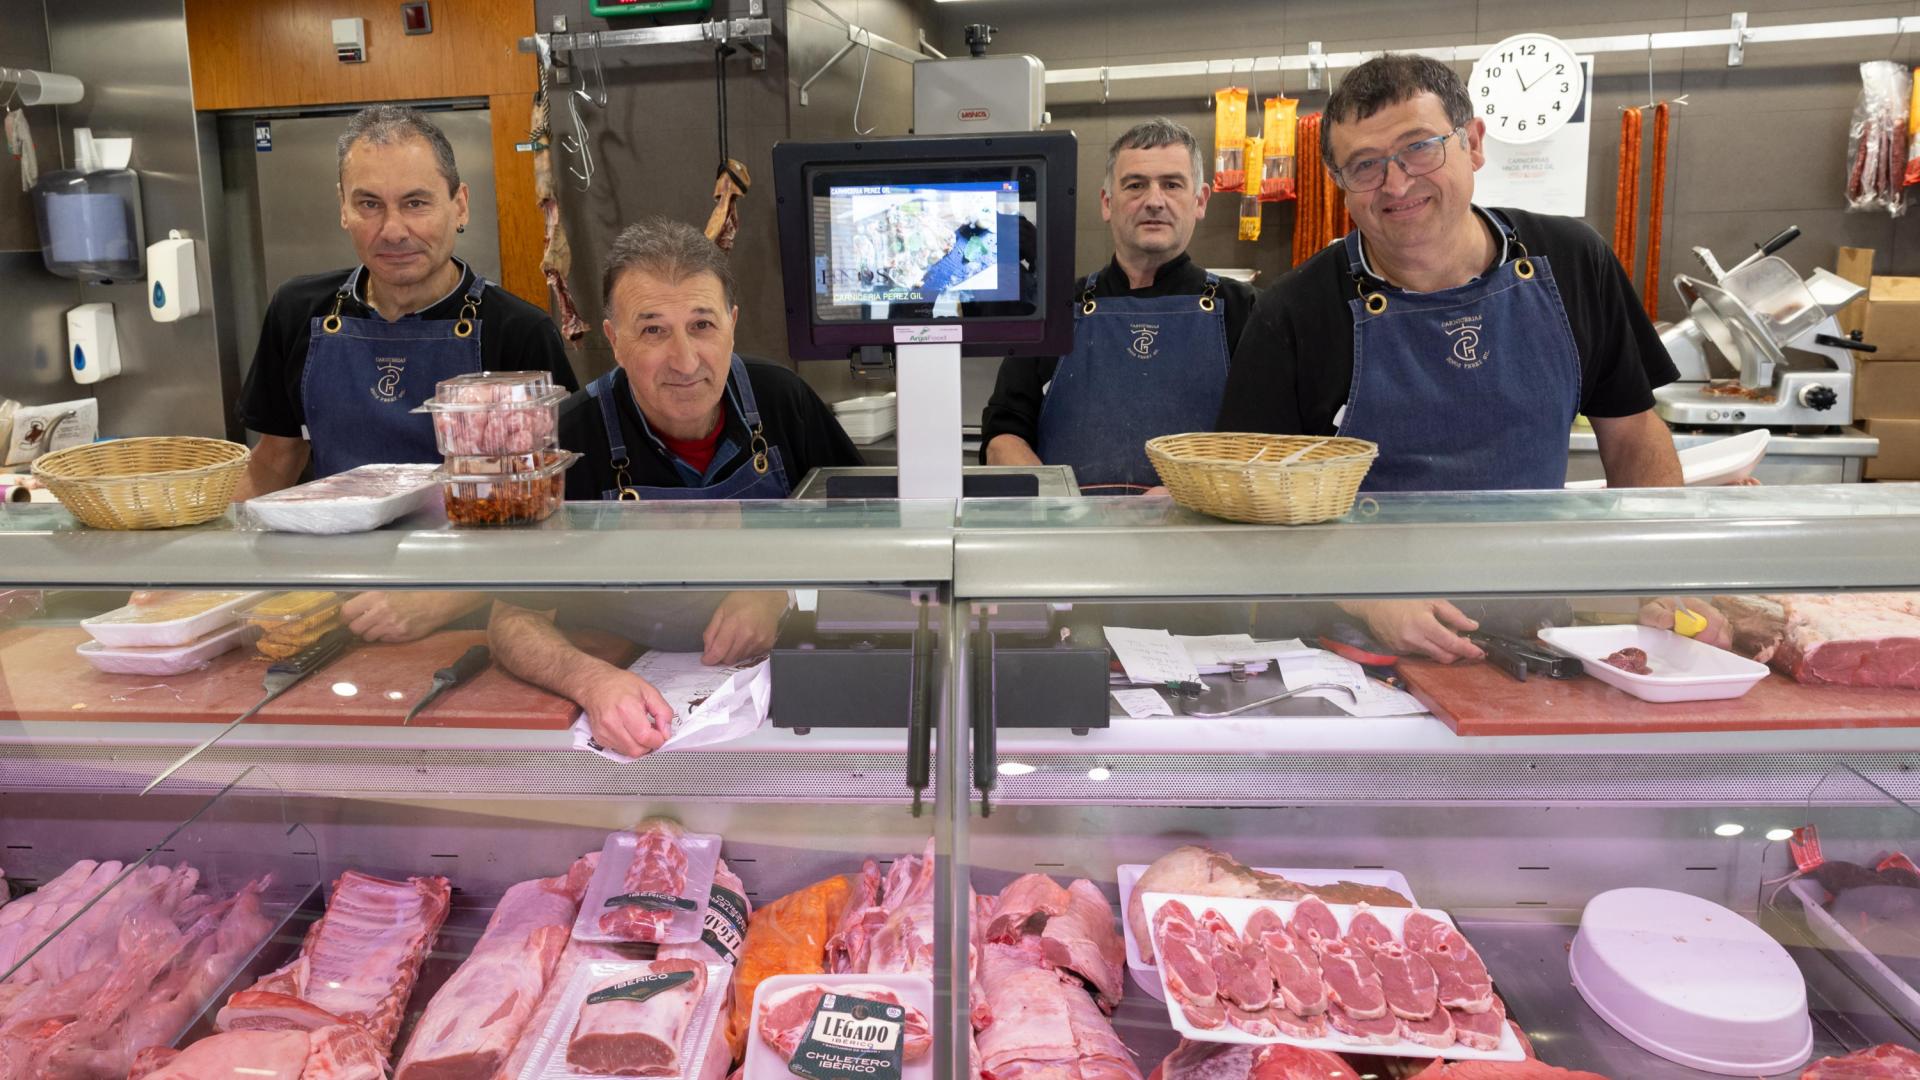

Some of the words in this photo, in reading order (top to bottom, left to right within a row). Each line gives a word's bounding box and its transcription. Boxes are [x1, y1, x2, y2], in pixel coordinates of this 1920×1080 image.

[1520, 44, 1536, 56] 12
[1500, 52, 1513, 63] 11
[1544, 52, 1550, 62] 1
[1486, 67, 1501, 78] 10
[1555, 63, 1565, 75] 2
[1481, 86, 1490, 97] 9
[1560, 82, 1569, 93] 3
[1486, 104, 1495, 114] 8
[1552, 100, 1561, 111] 4
[1500, 116, 1508, 127] 7
[1537, 114, 1546, 125] 5
[1518, 120, 1526, 131] 6
[834, 292, 881, 301] CARNICERIA
[883, 291, 909, 301] PEREZ
[910, 292, 923, 300] GIL
[822, 1016, 889, 1044] LEGADO
[805, 1051, 891, 1068] CHULETERO
